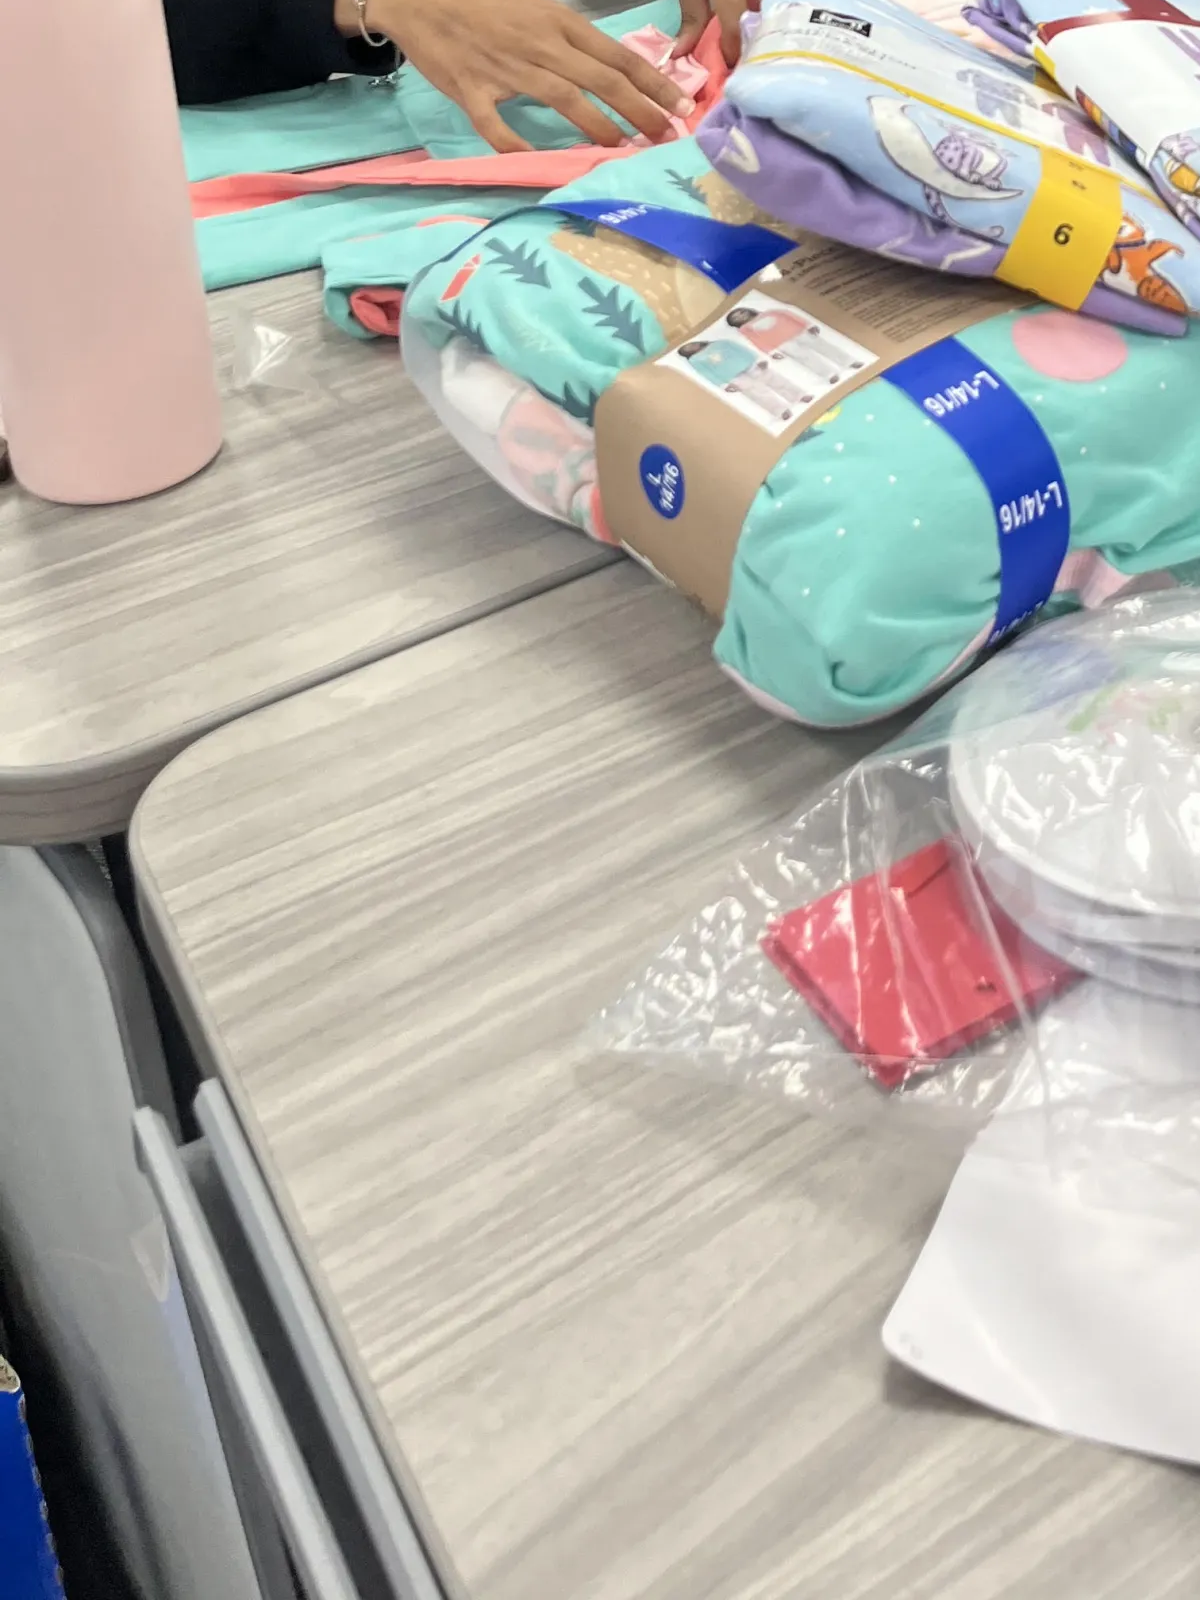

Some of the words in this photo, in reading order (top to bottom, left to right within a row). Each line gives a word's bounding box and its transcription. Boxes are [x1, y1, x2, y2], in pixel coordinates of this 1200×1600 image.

[1053, 222, 1074, 247] 6
[923, 370, 1000, 418] L-14/16
[645, 471, 662, 488] L
[659, 461, 680, 512] 14/16
[1000, 480, 1063, 534] L-14/16
